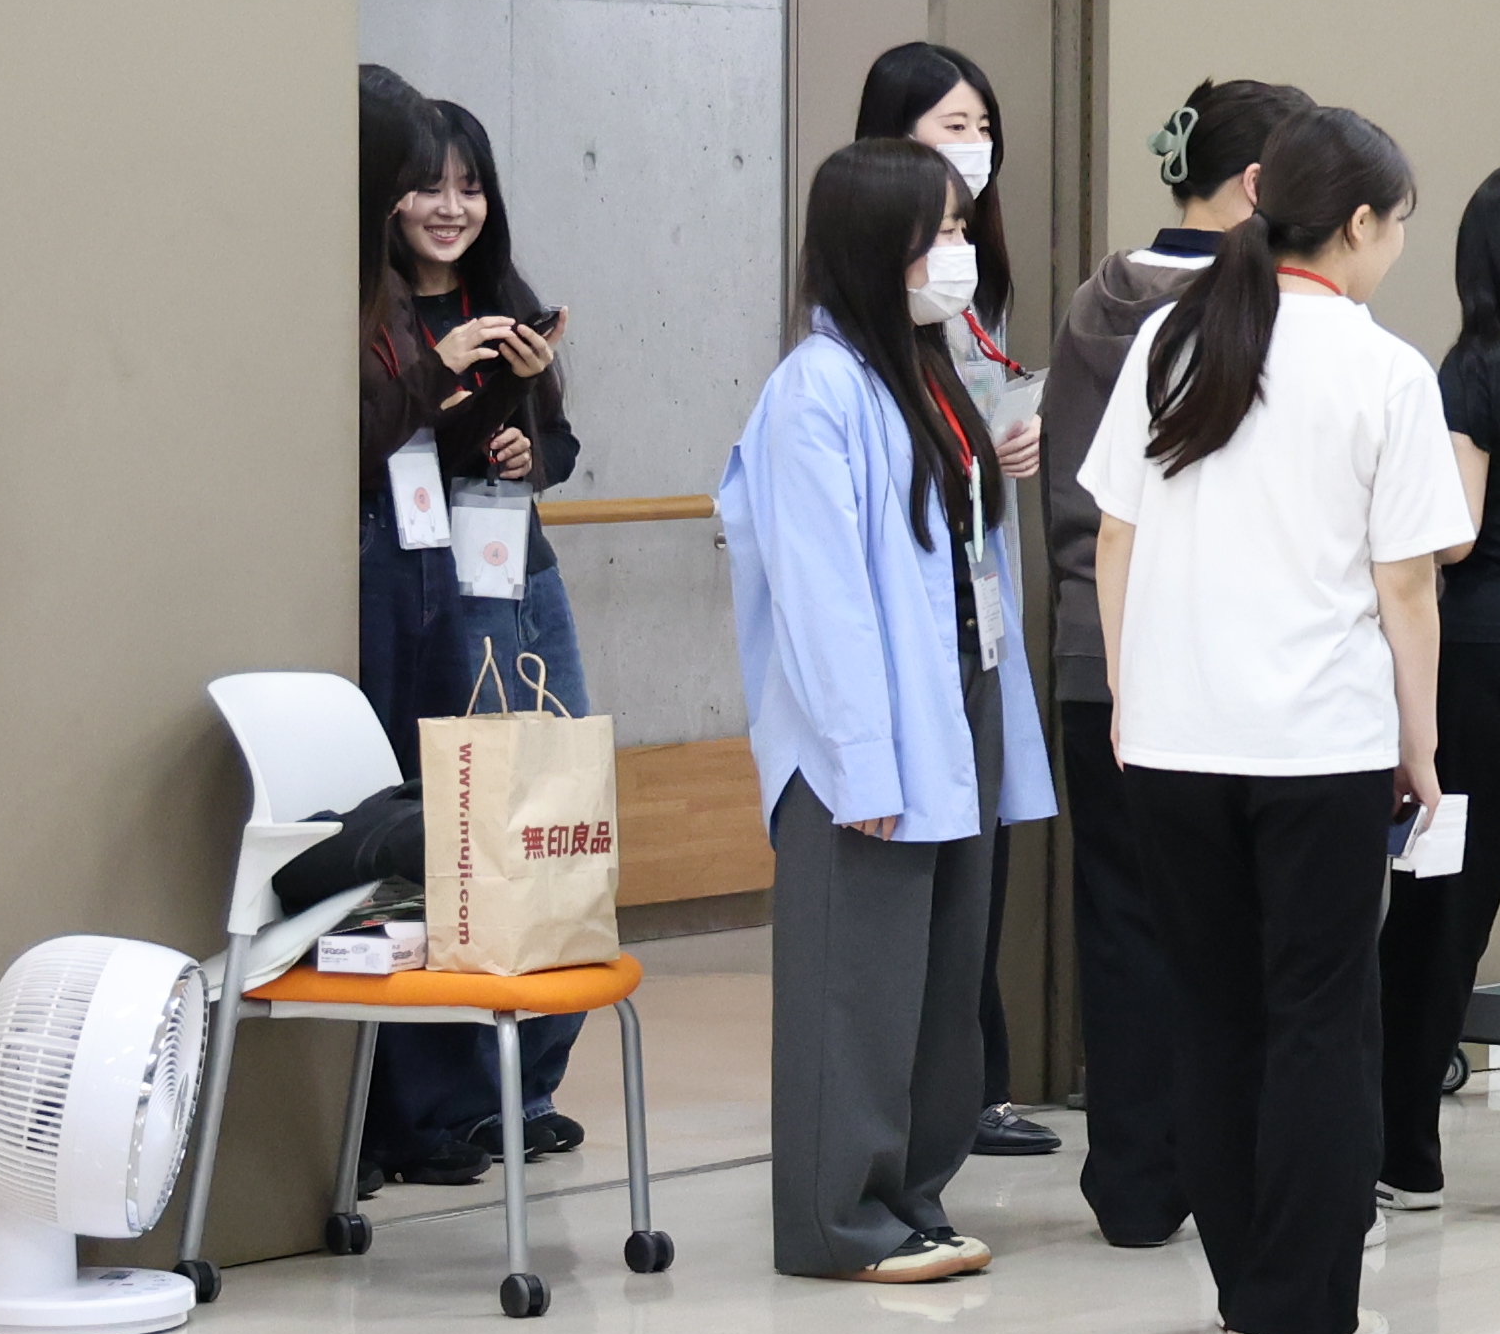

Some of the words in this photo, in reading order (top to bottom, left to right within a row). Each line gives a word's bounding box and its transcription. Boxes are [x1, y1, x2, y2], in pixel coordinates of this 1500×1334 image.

[457, 742, 472, 945] www.muji.com
[521, 820, 612, 860] 無印良品
